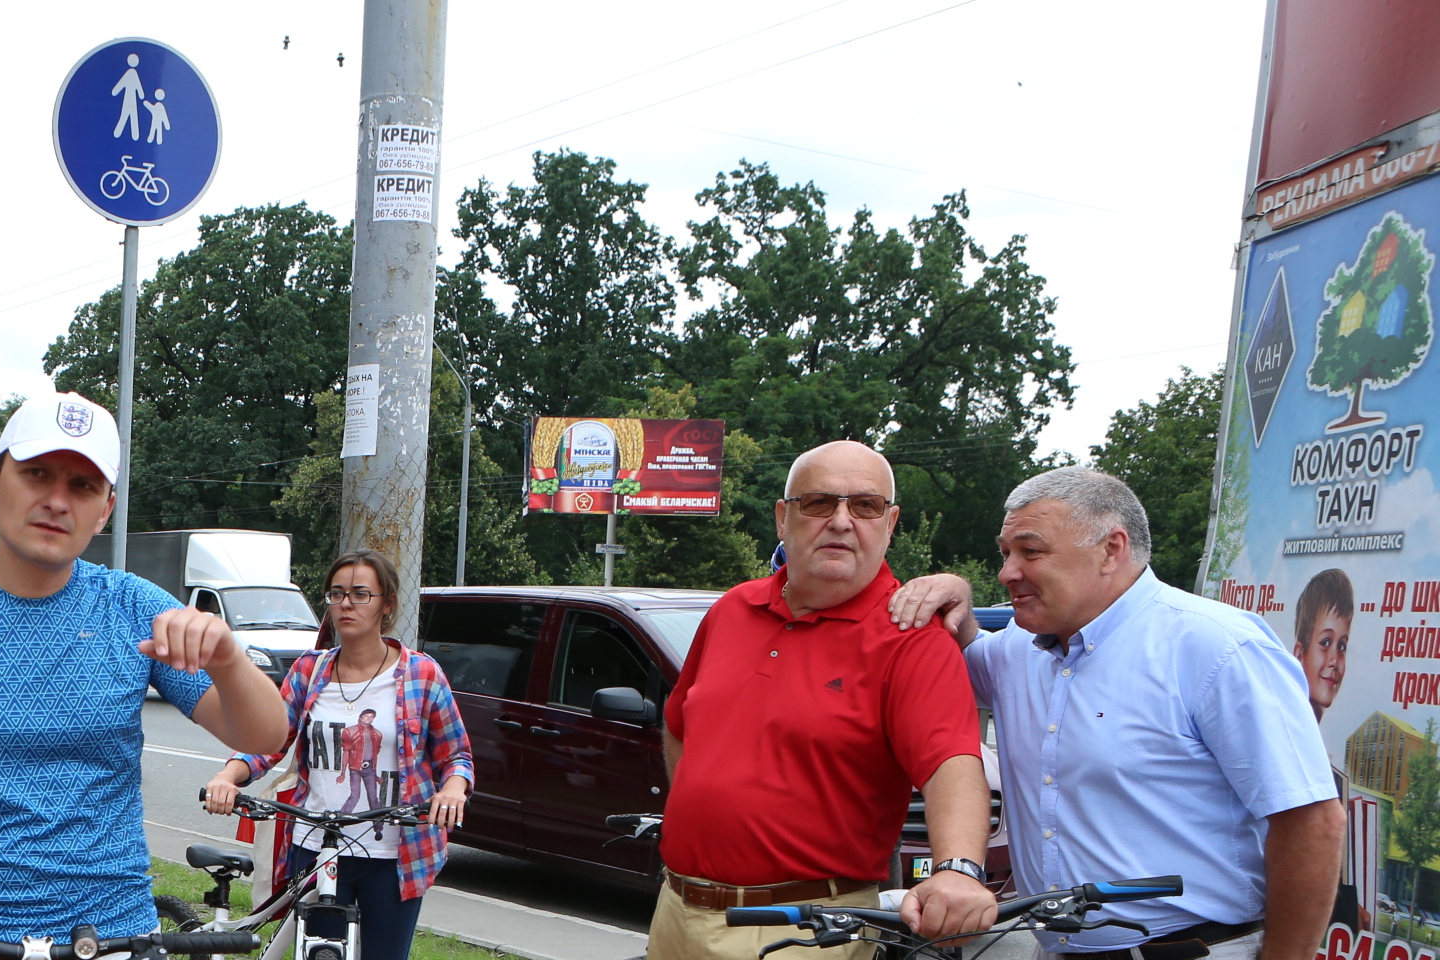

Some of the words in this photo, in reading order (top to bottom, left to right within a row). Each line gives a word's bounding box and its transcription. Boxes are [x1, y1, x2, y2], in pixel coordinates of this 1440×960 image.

[381, 128, 436, 146] КРЕДИТ
[377, 178, 433, 194] КРЕДИТ
[1261, 157, 1366, 223] РЕКЛАМА
[1255, 342, 1282, 374] КАН
[361, 373, 373, 382] НА
[1292, 430, 1421, 483] КОМФОРТ
[1318, 484, 1377, 525] ТАУН
[1283, 533, 1339, 554] житловий
[1340, 534, 1403, 553] комплекс
[1220, 579, 1255, 611] Місто
[1380, 581, 1406, 617] до
